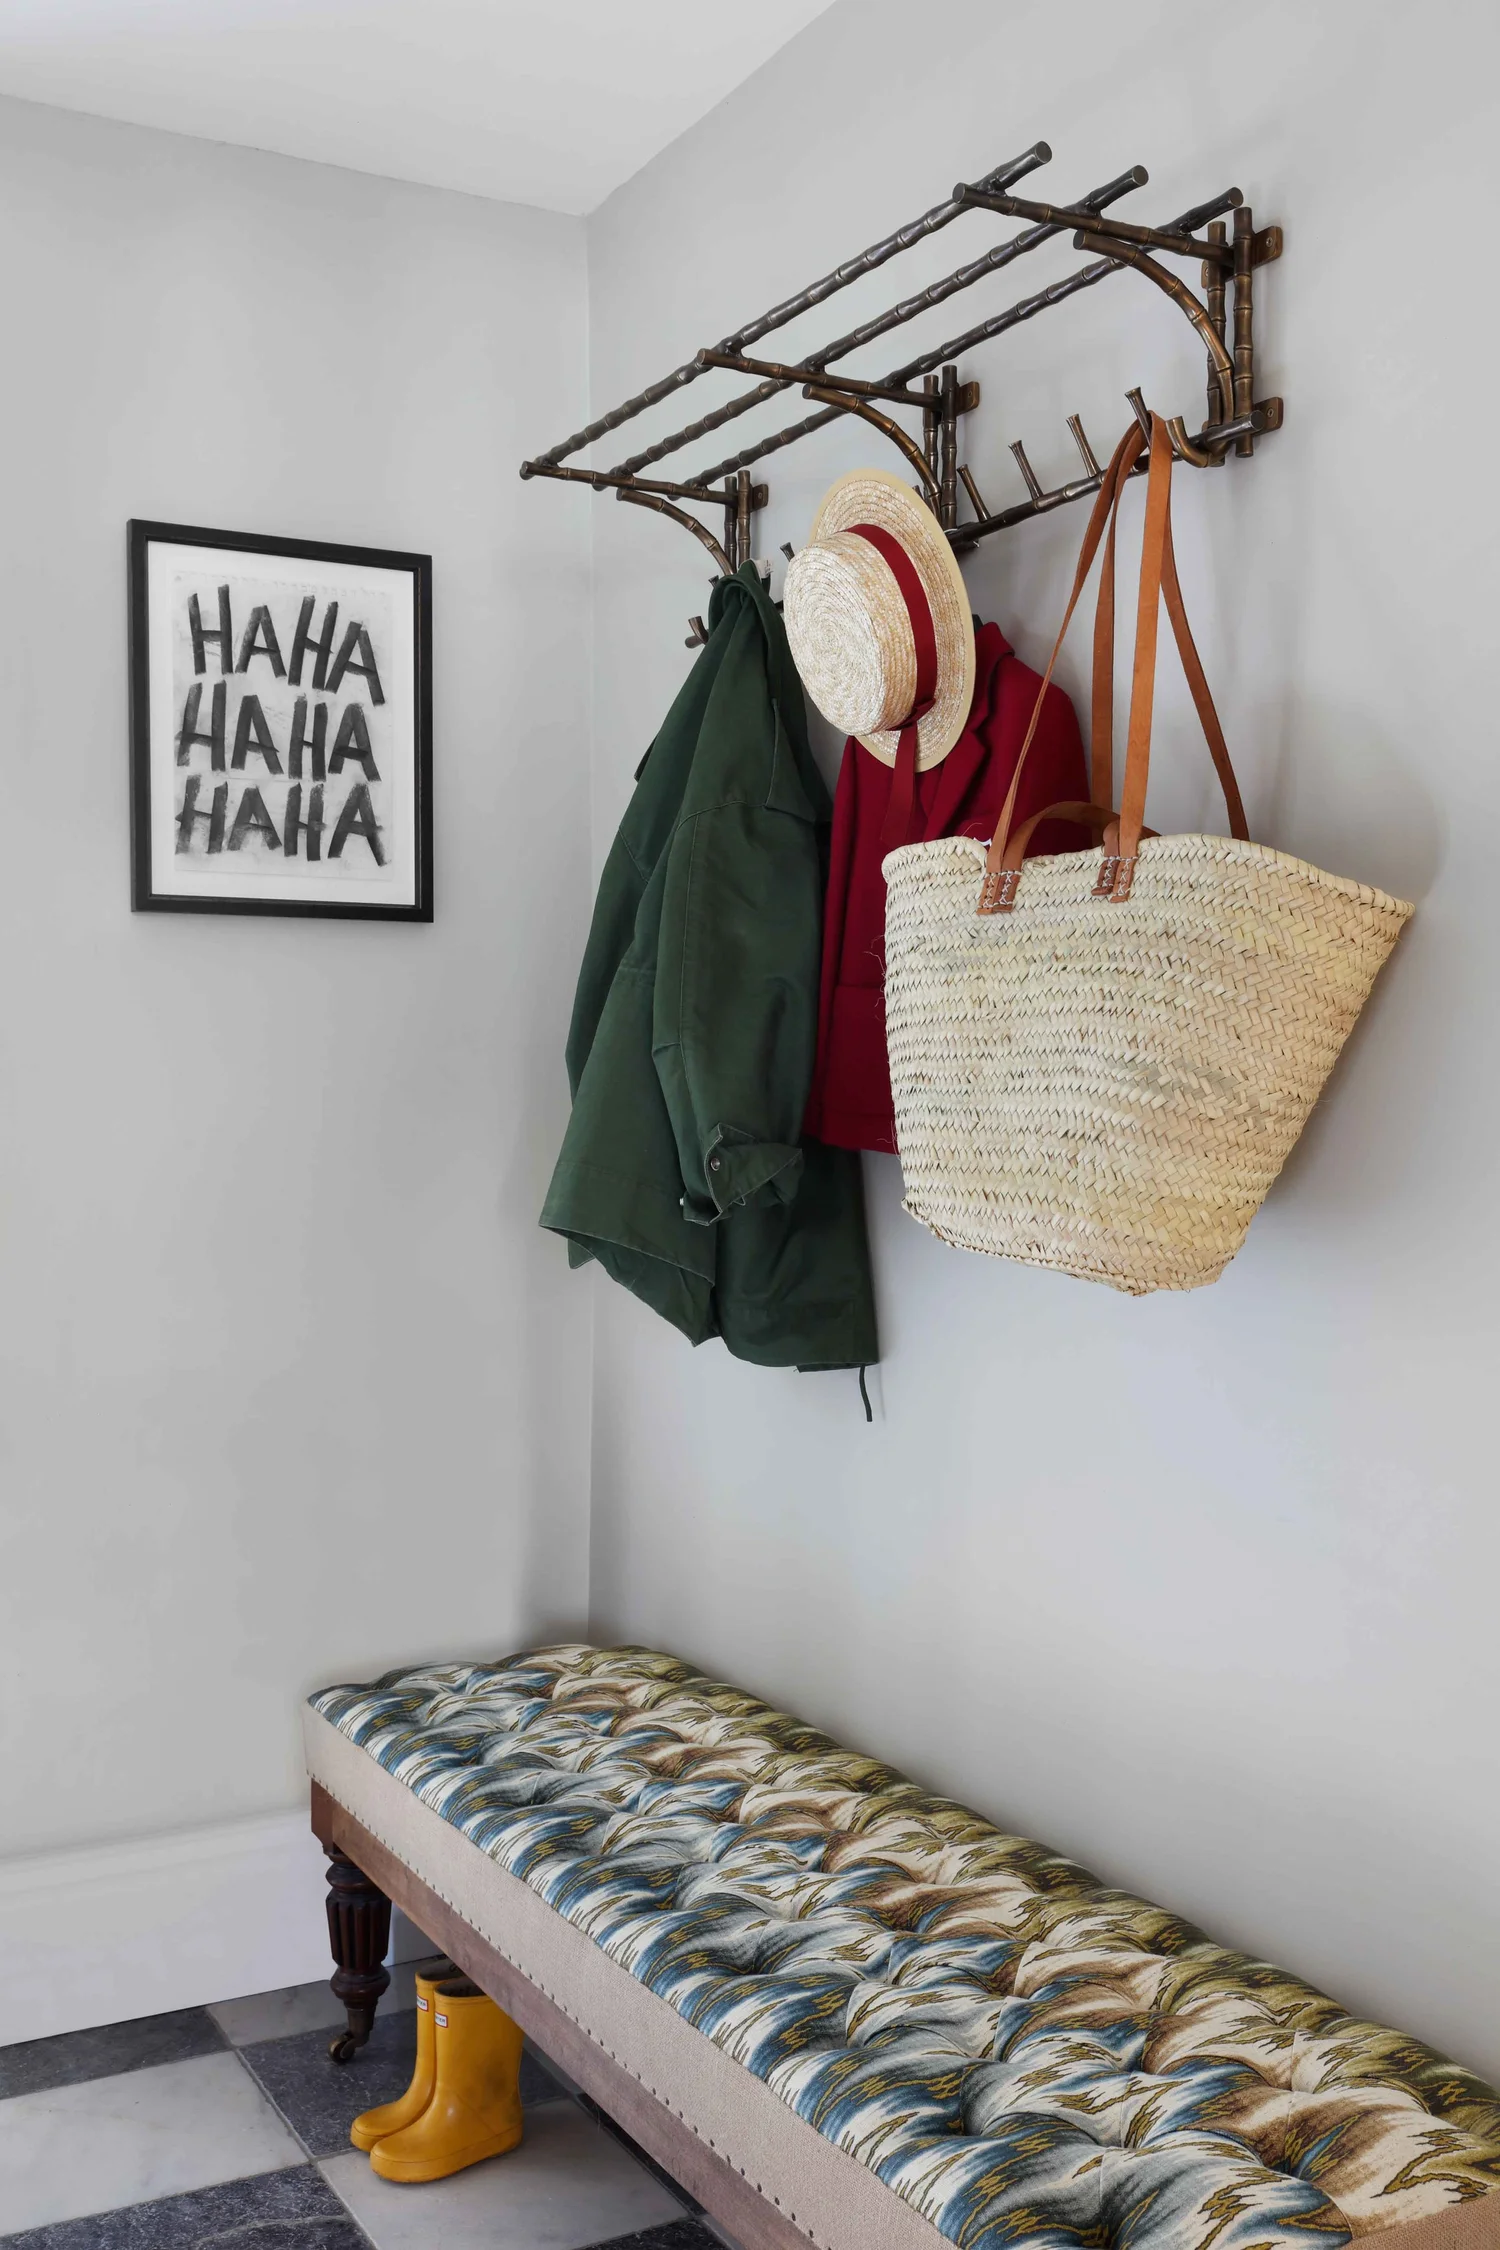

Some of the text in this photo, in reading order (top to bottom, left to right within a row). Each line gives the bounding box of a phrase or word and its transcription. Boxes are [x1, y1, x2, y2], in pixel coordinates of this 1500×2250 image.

[187, 584, 386, 708] HAHA
[175, 679, 382, 783] HAHA
[174, 774, 387, 867] HAHA
